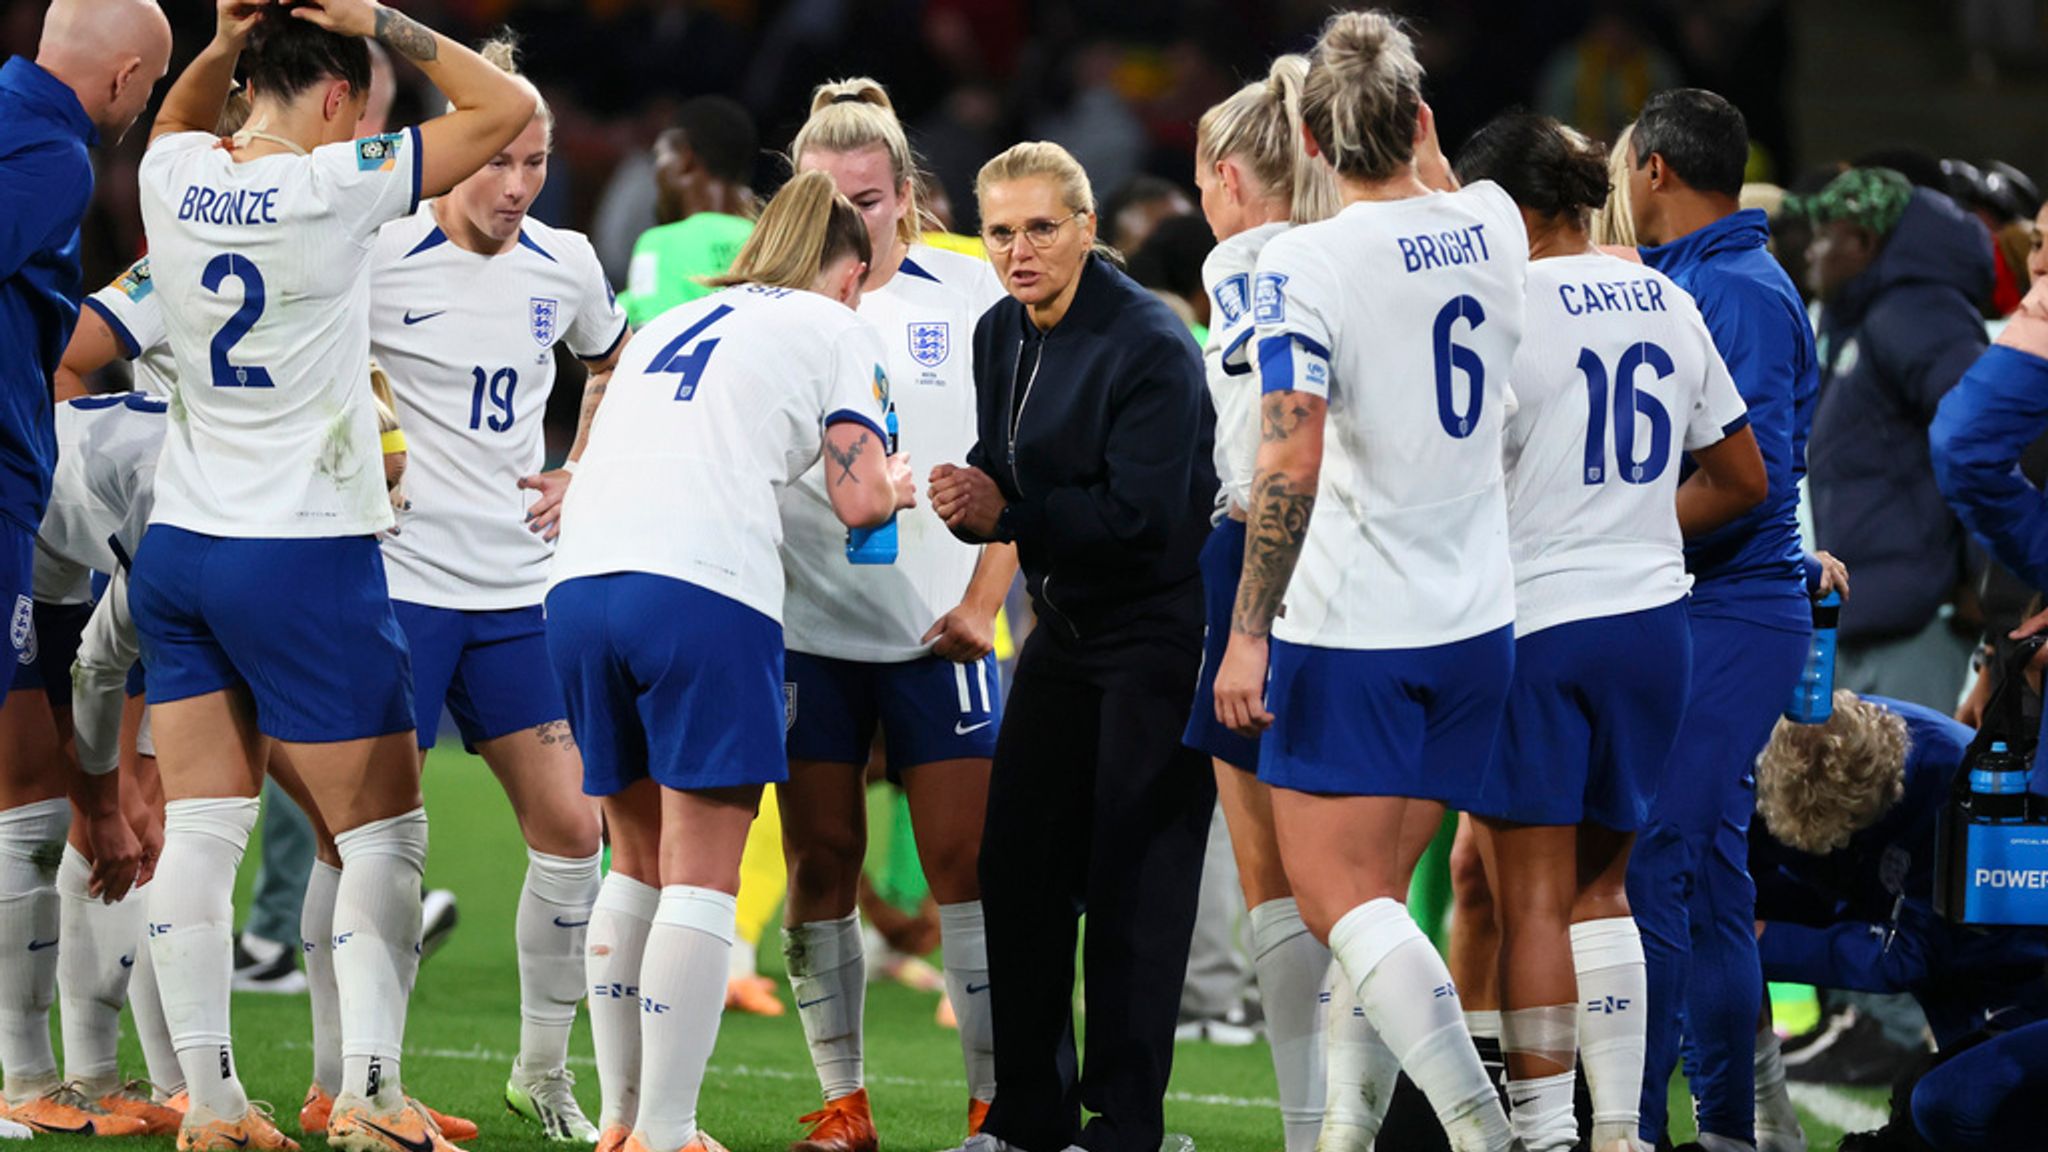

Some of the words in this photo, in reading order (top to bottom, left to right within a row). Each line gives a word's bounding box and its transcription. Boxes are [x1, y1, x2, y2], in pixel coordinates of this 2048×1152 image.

[178, 185, 279, 225] BRONZE
[1397, 224, 1491, 274] BRIGHT
[200, 253, 275, 389] 2
[1558, 278, 1668, 317] CARTER
[634, 302, 736, 402] 4
[1432, 294, 1487, 440] 6
[469, 365, 519, 433] 19
[1575, 341, 1676, 486] 16
[953, 657, 992, 713] 11
